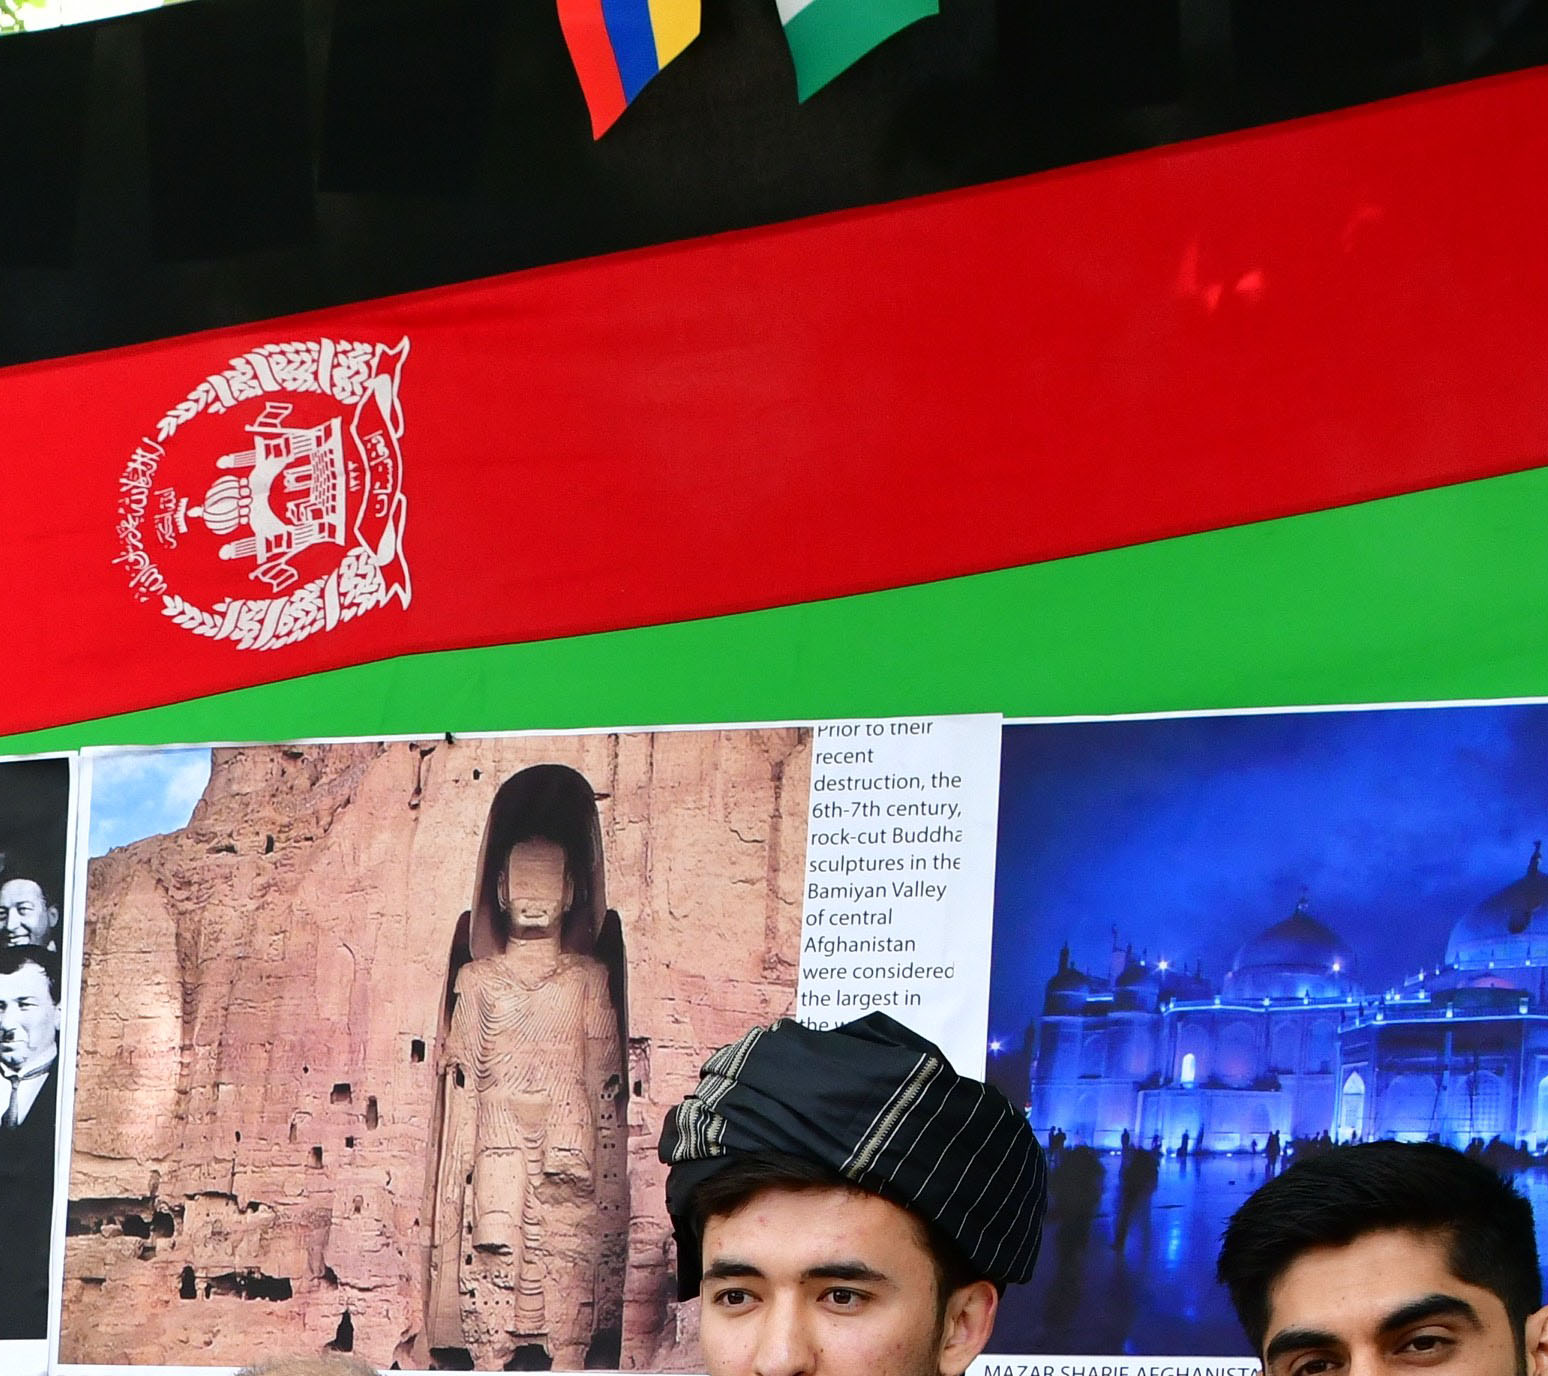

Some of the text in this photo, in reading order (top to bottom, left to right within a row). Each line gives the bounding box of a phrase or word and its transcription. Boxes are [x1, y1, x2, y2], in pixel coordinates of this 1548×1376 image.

[866, 724, 884, 736] to
[816, 749, 873, 764] recent
[814, 772, 961, 791] destruction, the
[813, 801, 961, 819] 6th-7th century,
[812, 828, 886, 845] rock-cut
[810, 856, 904, 874] sculptures
[911, 855, 926, 869] in
[809, 881, 946, 902] Bamiyan Valley
[806, 909, 892, 926] of central
[805, 936, 915, 956] Afghanistan
[803, 968, 847, 979] were
[802, 990, 920, 1009] the largest in
